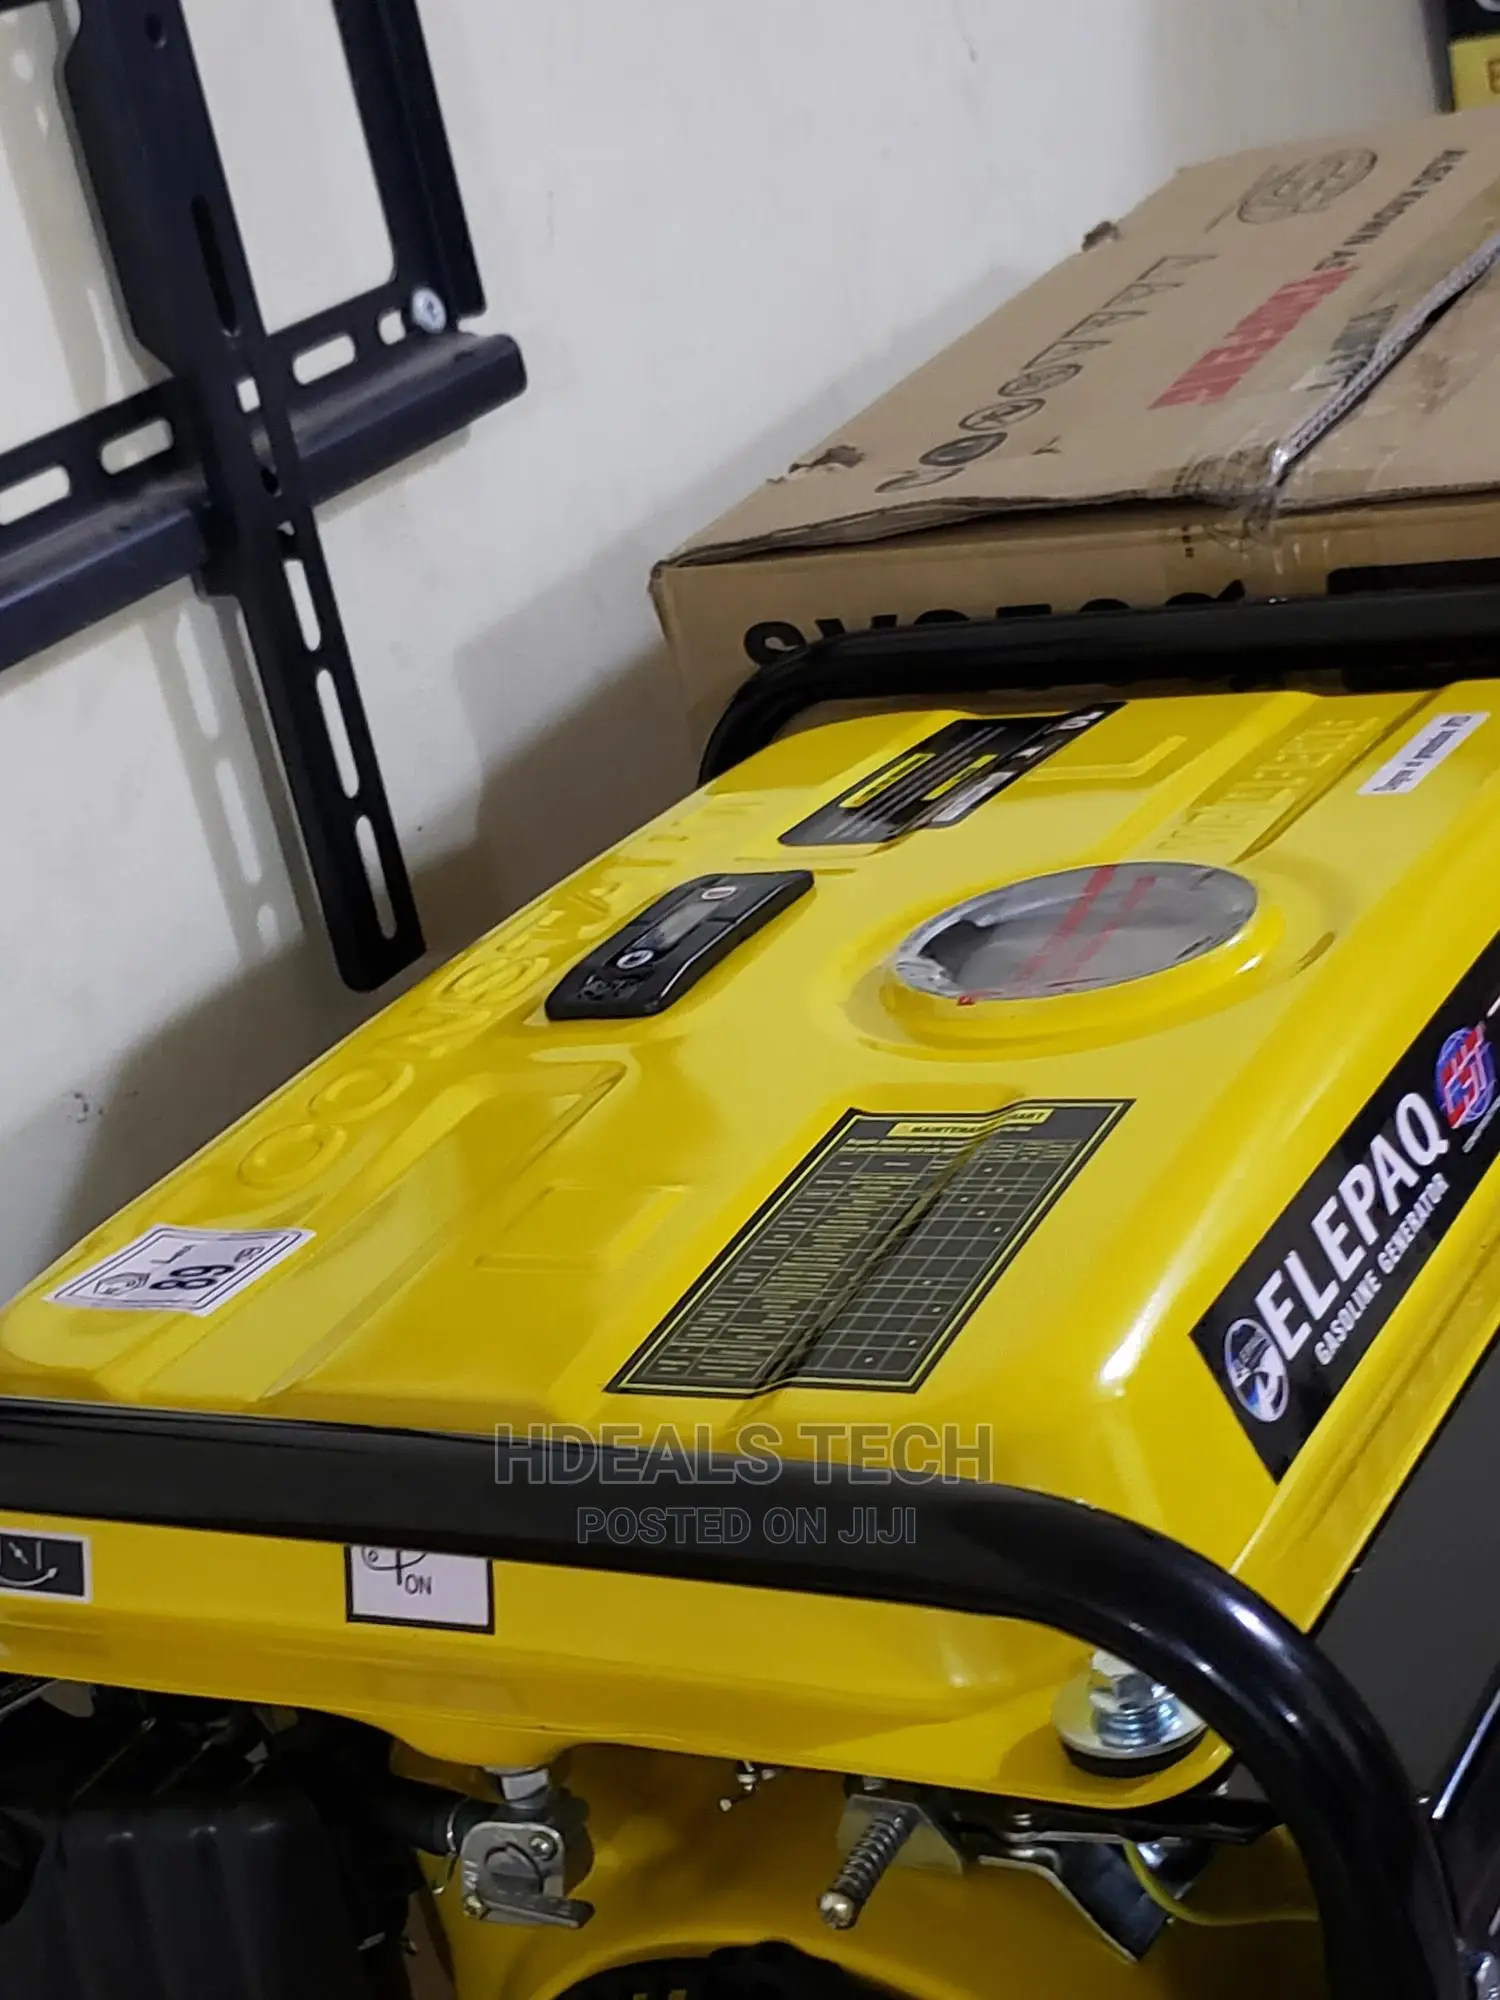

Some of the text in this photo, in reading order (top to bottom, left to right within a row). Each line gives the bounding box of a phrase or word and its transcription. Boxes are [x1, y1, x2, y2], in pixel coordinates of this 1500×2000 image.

[149, 1264, 236, 1291] 89
[1254, 1092, 1450, 1361] ELEPAQ
[1314, 1172, 1450, 1366] GASOLINE GENERATOR
[405, 1573, 432, 1595] ON
